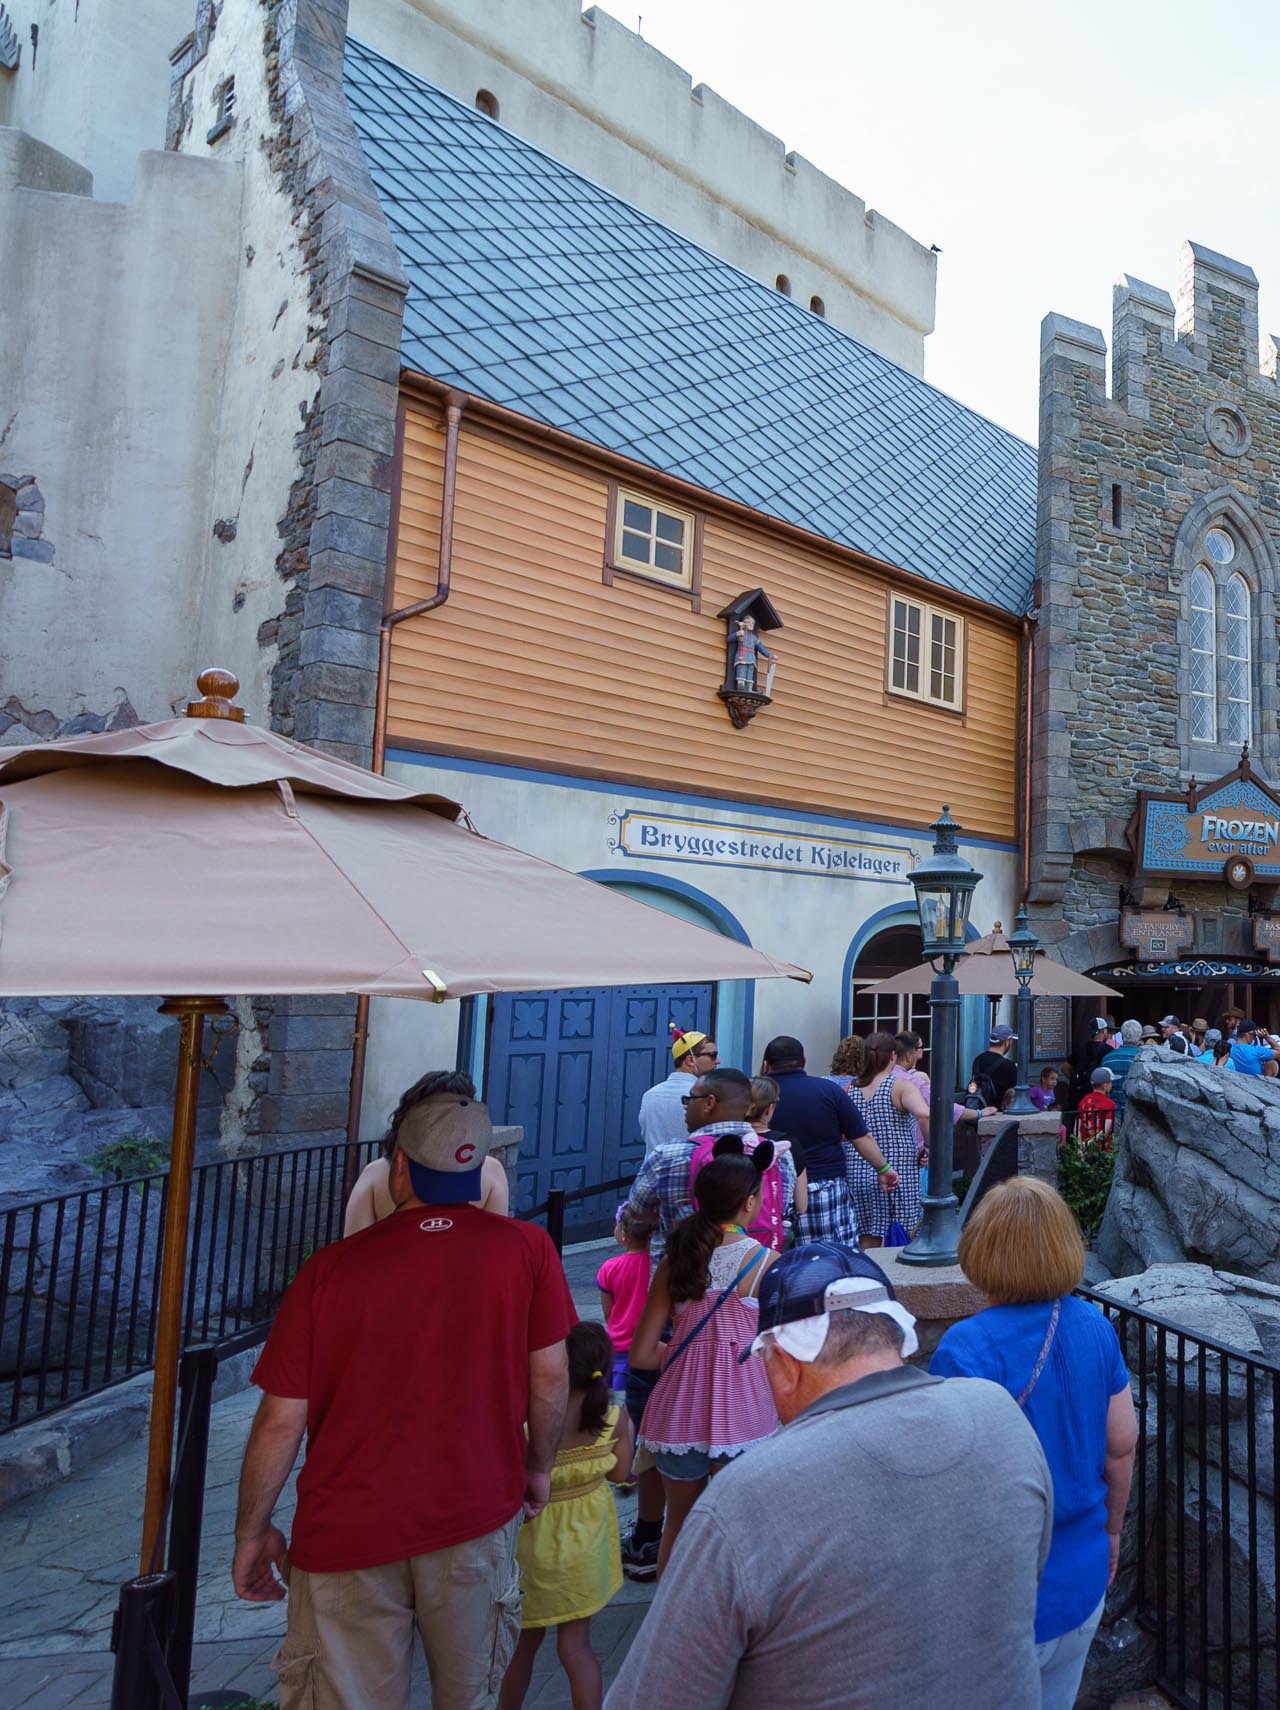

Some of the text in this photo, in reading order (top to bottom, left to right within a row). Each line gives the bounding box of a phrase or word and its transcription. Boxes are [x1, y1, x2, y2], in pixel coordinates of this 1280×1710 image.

[1200, 815, 1279, 847] FROZEN
[641, 825, 900, 874] Bryggestredet Kjølelager
[1208, 842, 1270, 855] ever after
[1132, 929, 1185, 938] ENTRANCE
[1136, 922, 1180, 930] STANDBY
[455, 1143, 476, 1165] C
